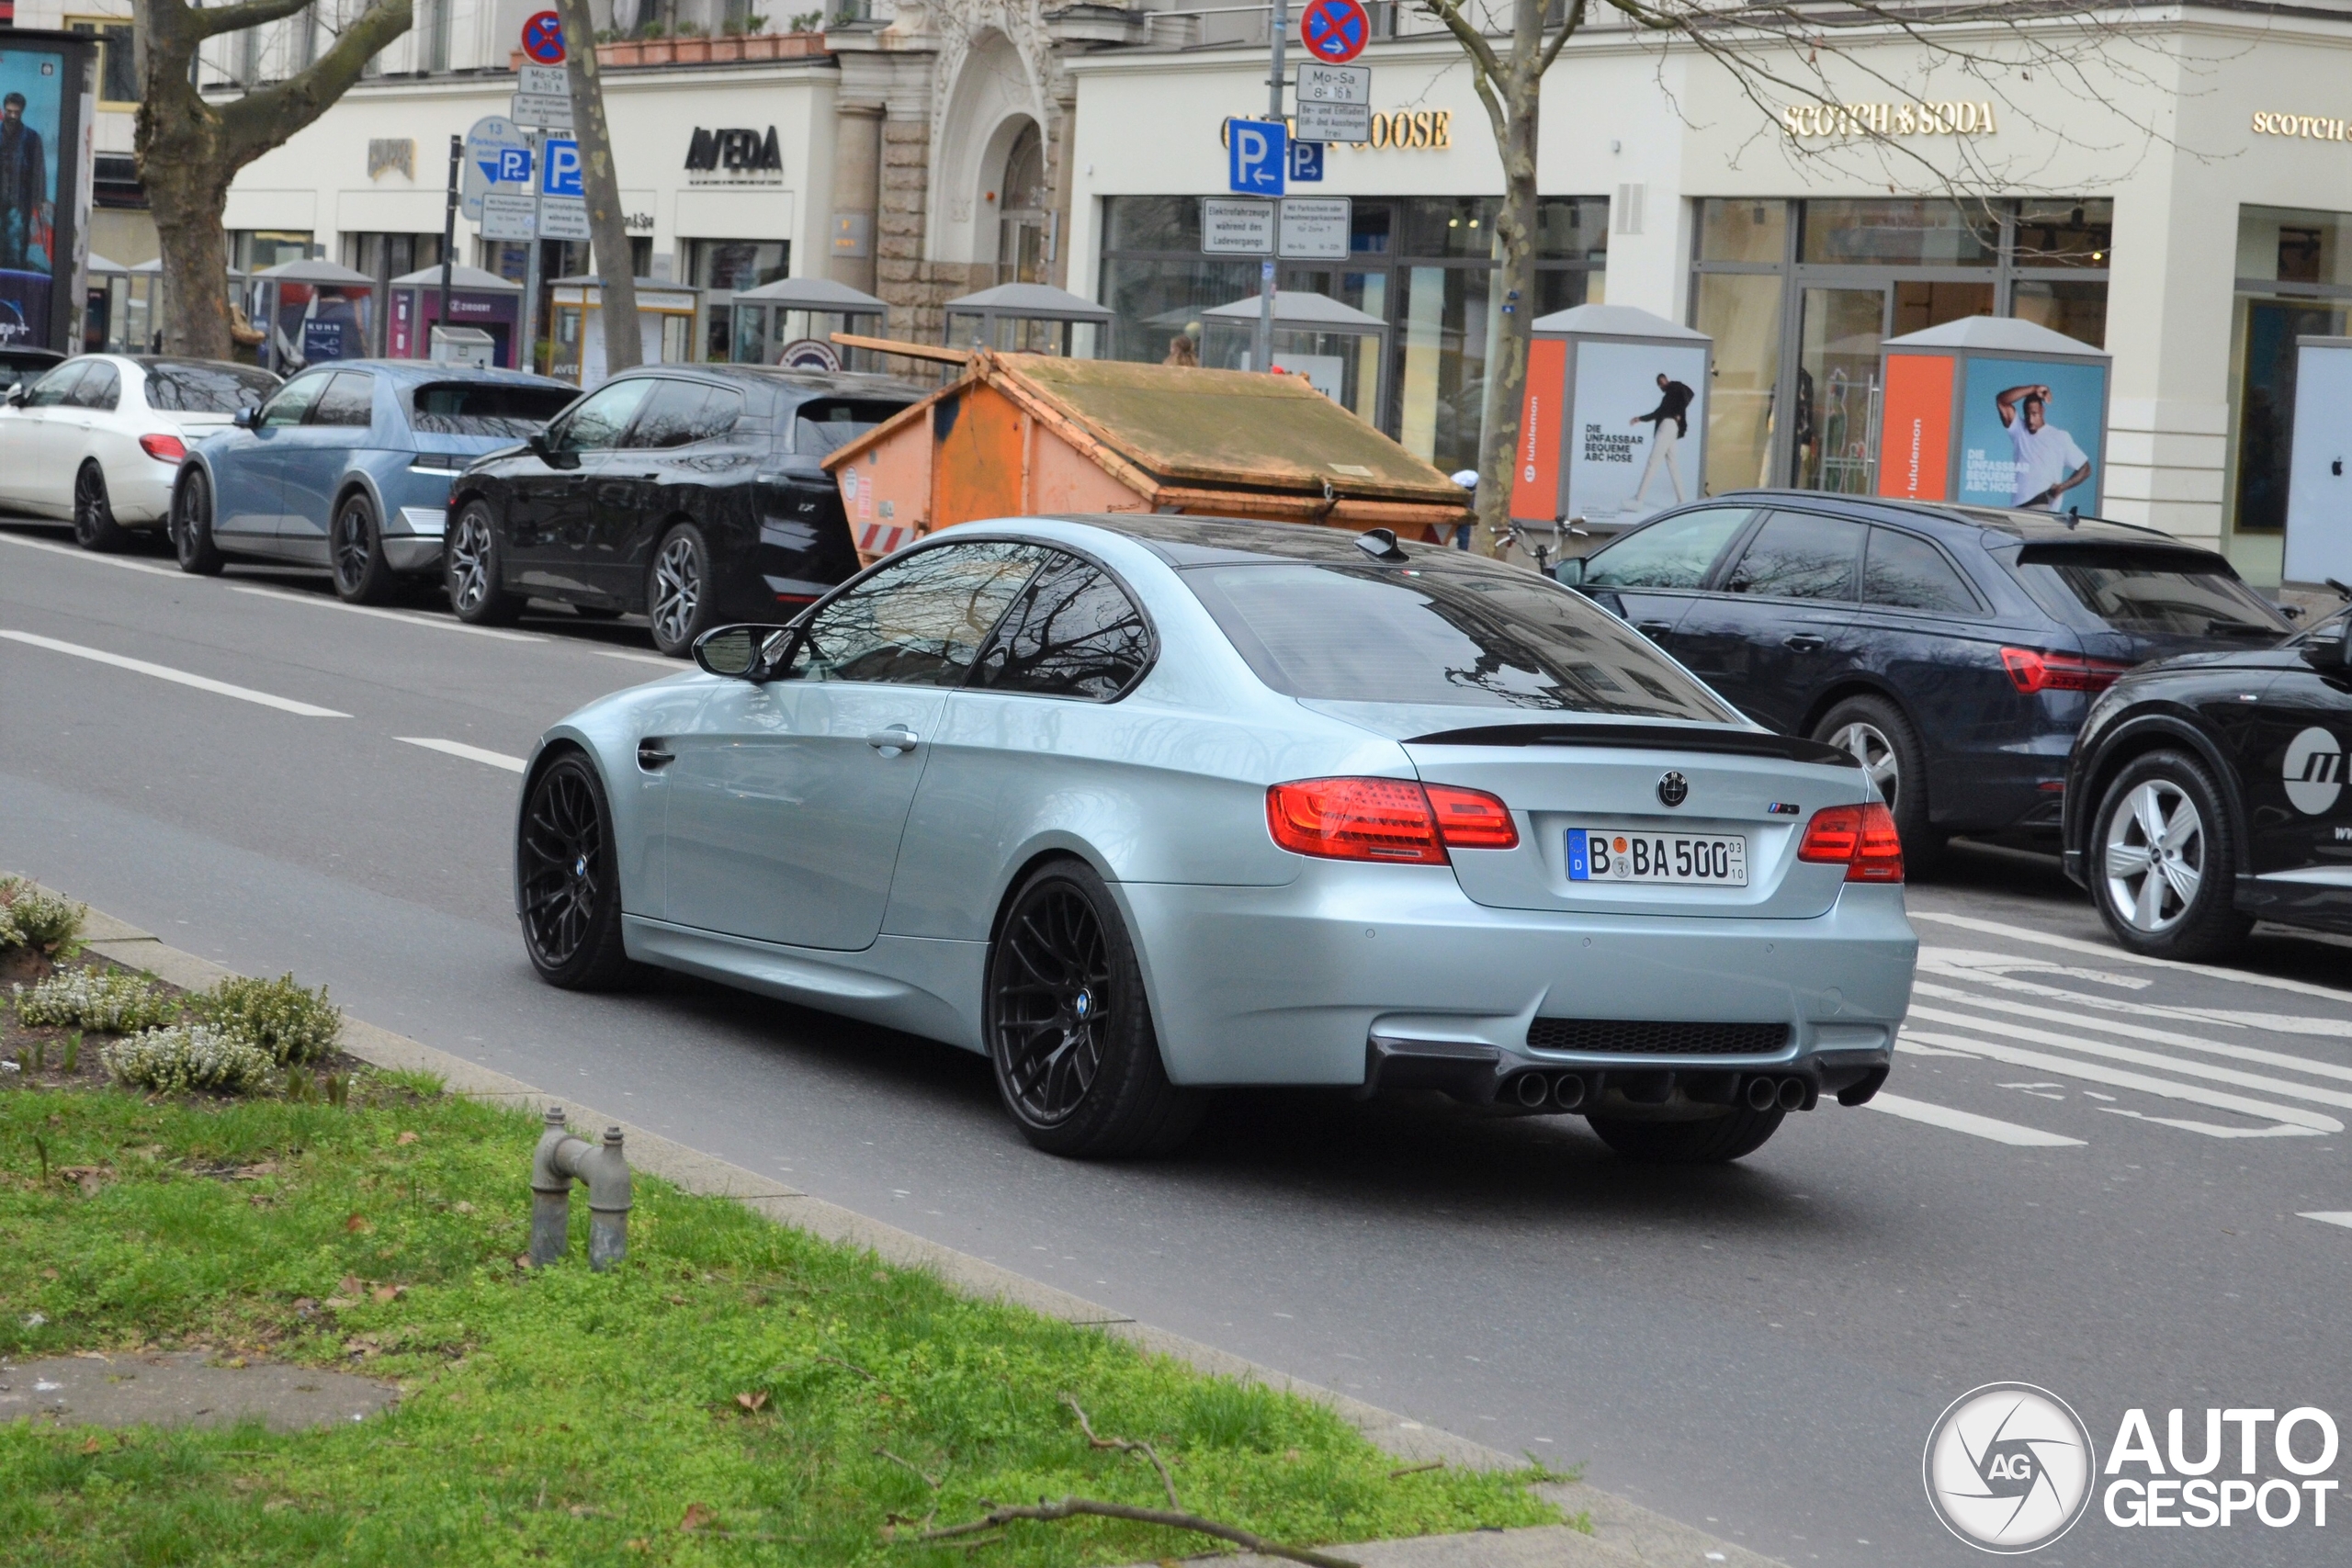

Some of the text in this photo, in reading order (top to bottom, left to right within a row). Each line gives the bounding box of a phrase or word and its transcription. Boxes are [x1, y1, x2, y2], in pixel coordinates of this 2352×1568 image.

[1312, 71, 1355, 85] Mo-Sa
[1782, 101, 1997, 138] SCOTCH & SODA
[2251, 110, 2344, 141] SCOTCH
[490, 123, 503, 135] 13
[684, 125, 784, 172] AVEDA
[1237, 129, 1268, 184] P
[1294, 143, 1314, 177] P
[503, 152, 523, 178] P
[551, 146, 582, 188] P
[1208, 206, 1271, 218] Elektrofahrzeuge
[1216, 220, 1262, 231] während des
[1213, 236, 1263, 248] Ladevorgangs
[1526, 396, 1538, 462] lululemon
[1586, 423, 1601, 433] DIE
[1585, 434, 1644, 445] UNFASSBAR
[1585, 443, 1631, 454] BEQUEME
[1907, 418, 1922, 491] lululemon
[1967, 449, 1985, 460] DIE
[1584, 453, 1633, 463] ABC HOSE
[1967, 460, 2030, 473] UNFASSBAR
[1966, 470, 2017, 482] BEQUEME
[1965, 481, 2018, 493] ABC HOSE
[1661, 772, 1687, 785] BMW
[1729, 842, 1742, 853] 03
[1589, 837, 1728, 878] B BA 500
[1574, 860, 1582, 871] D
[1732, 868, 1744, 879] 10
